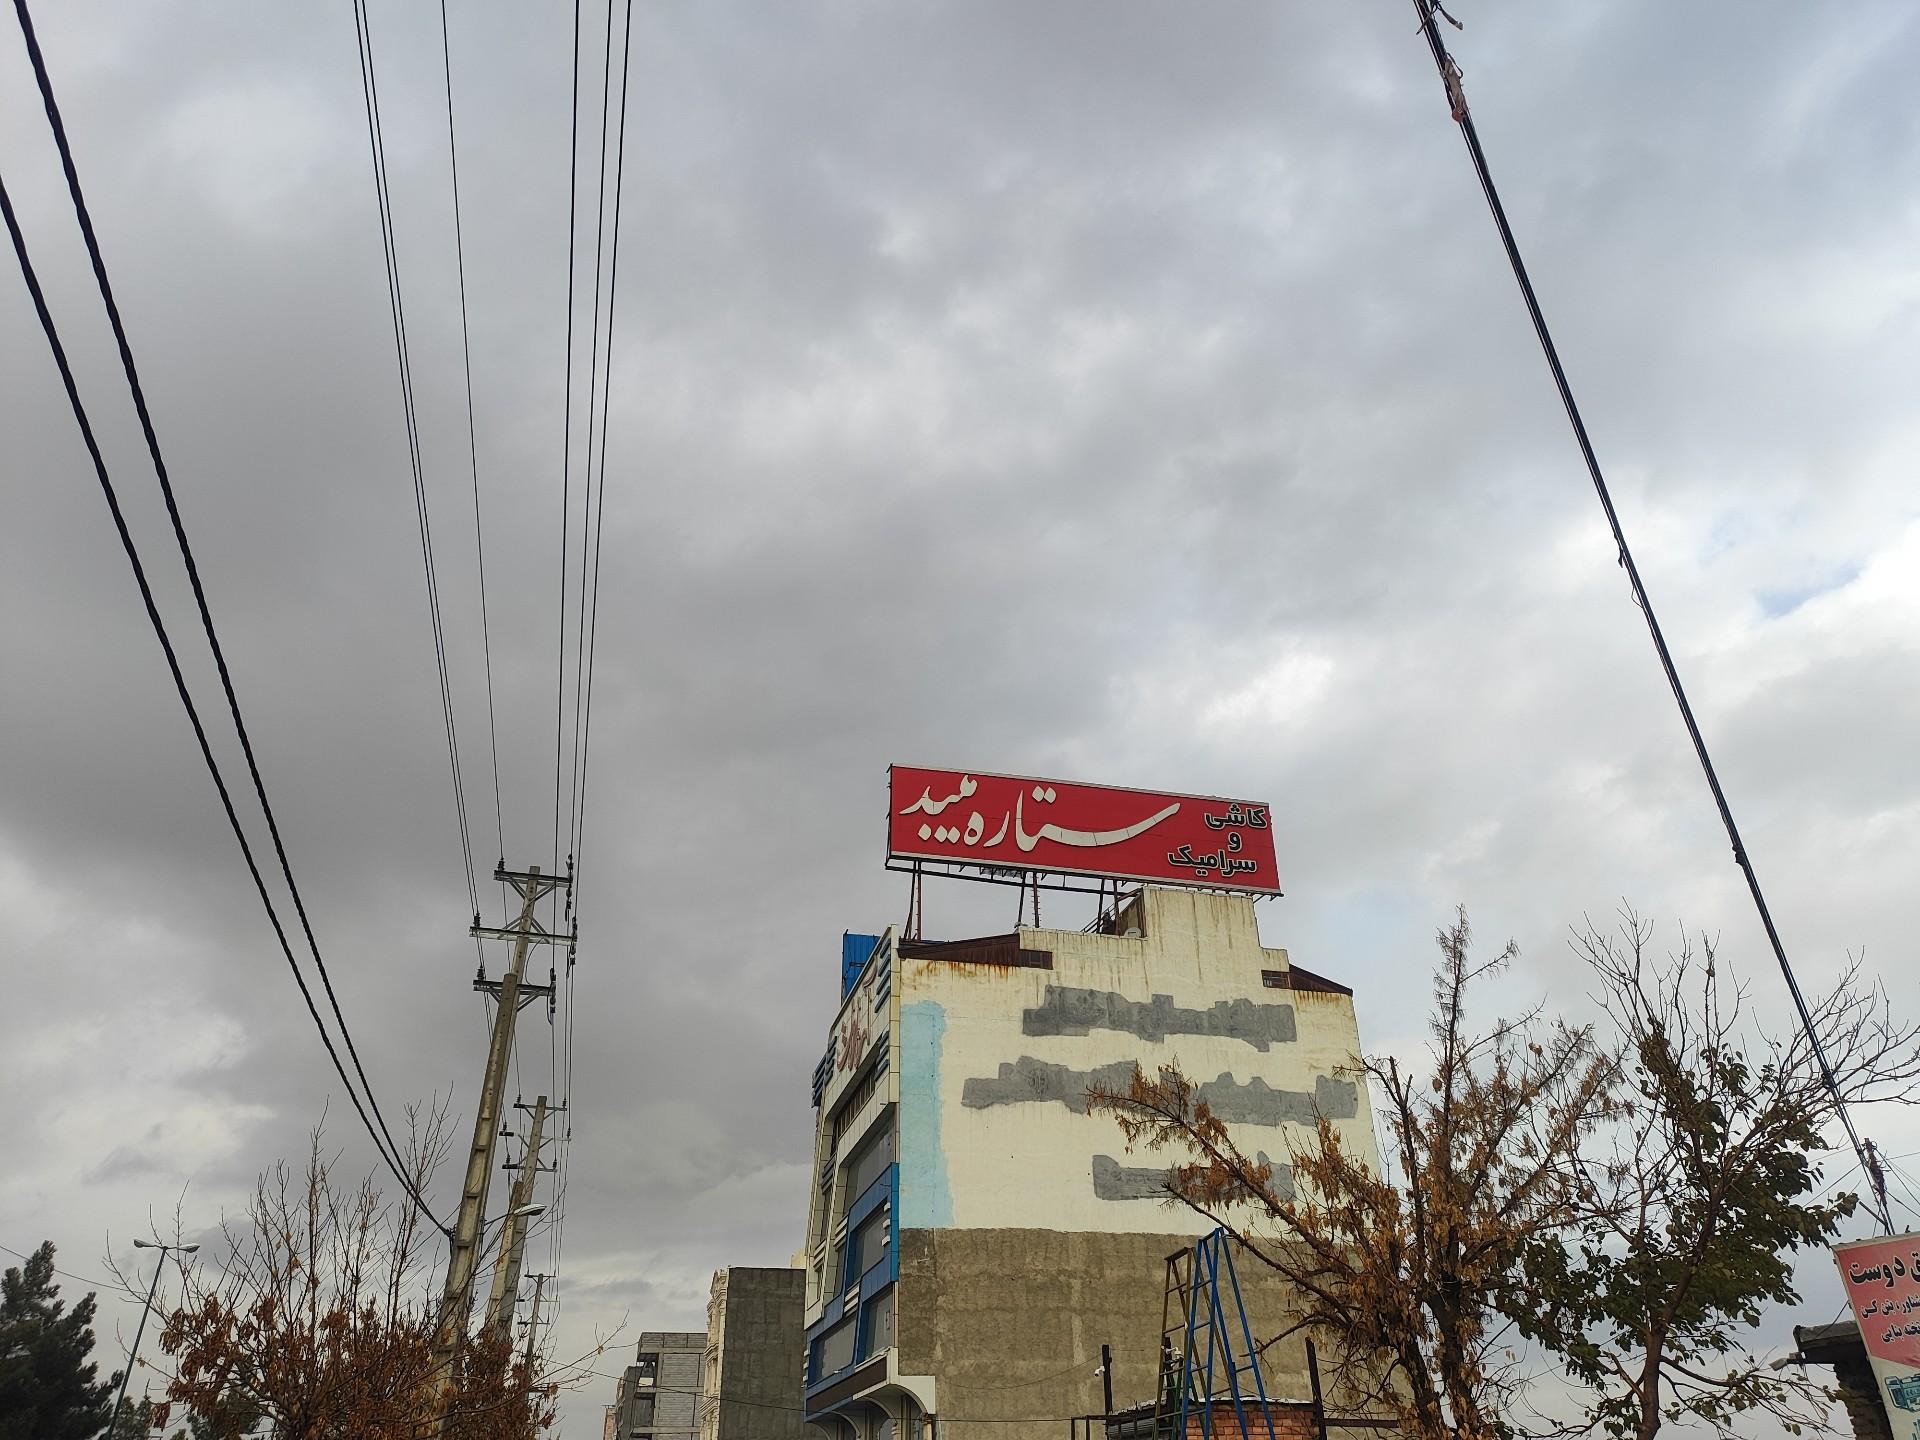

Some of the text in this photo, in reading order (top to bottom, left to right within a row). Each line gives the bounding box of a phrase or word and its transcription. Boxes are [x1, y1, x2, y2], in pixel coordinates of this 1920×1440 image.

[898, 774, 1181, 853] ستاره میبد
[1203, 802, 1268, 830] کاشی
[1227, 832, 1243, 852] و
[1167, 844, 1257, 877] سرامیک
[1849, 1255, 1907, 1289] دوست
